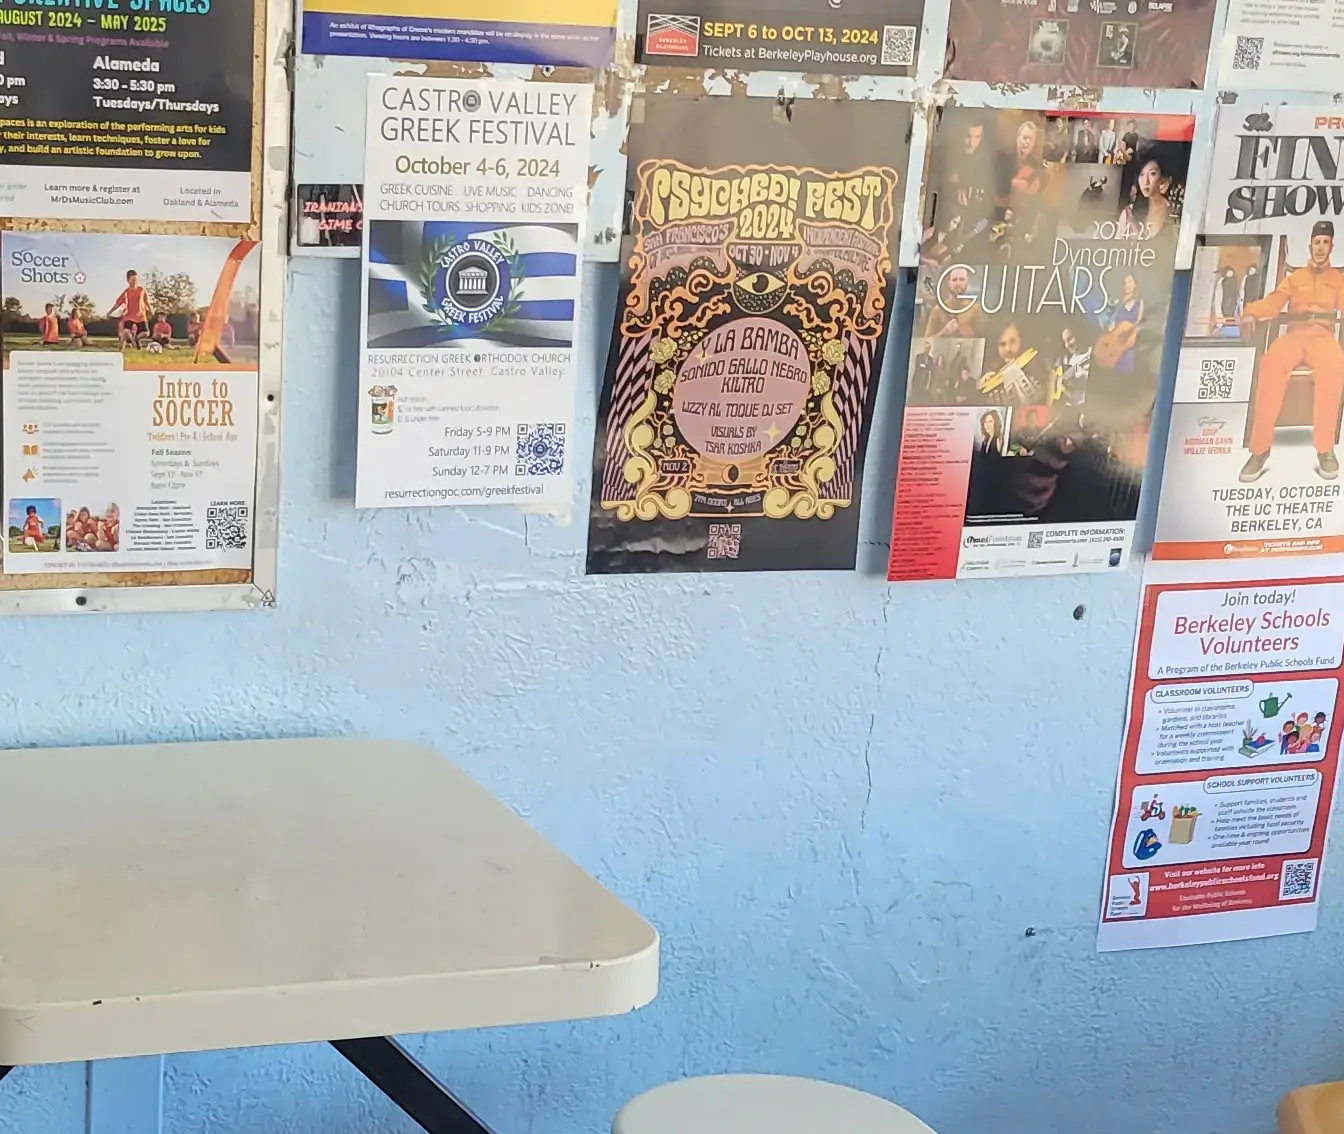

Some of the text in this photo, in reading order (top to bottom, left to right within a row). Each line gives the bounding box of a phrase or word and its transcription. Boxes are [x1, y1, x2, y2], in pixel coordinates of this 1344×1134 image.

[48, 11, 83, 29] 2024
[100, 14, 129, 30] MAY
[134, 16, 167, 32] 2025
[703, 22, 878, 44] SEPT 6 to OCT 13, 2024
[92, 55, 161, 73] Alameda
[702, 45, 877, 65] Tickets at BerkeleyPlayhouse.org
[93, 96, 220, 113] Tuesdays/Thursdays
[382, 88, 577, 116] CASTRO VALLEY
[380, 116, 576, 146] GREEK FESTIVAL
[395, 155, 560, 179] October 4-6, 2024
[649, 168, 882, 230] PSYCHED! FEST
[739, 204, 794, 238] 2024
[1092, 220, 1153, 242] 2024-25
[11, 251, 69, 268] Soccer
[1051, 238, 1155, 270] Dynamite
[21, 267, 69, 284] Shots
[935, 263, 1113, 315] GUITARS
[702, 327, 798, 360] Y LA BAMBA
[680, 358, 807, 384] SONIDO GALLO NEGRO
[158, 375, 229, 399] Intro to
[721, 377, 765, 393] KILTRO
[152, 400, 234, 428] SOCCER
[444, 426, 510, 438] Friday 5-9 PM
[433, 465, 508, 477] Sunday 12-7 PM
[662, 462, 689, 472] NOV 2
[1212, 488, 1274, 503] TUESDAY,
[1279, 485, 1339, 500] OCTOBER
[1225, 501, 1333, 517] THE UC THEATRE
[1231, 517, 1323, 533] BERKELEY, CA
[1221, 589, 1297, 608] Join today!
[1174, 608, 1331, 635] Berkeley Schools
[1199, 635, 1299, 657] Volunteers
